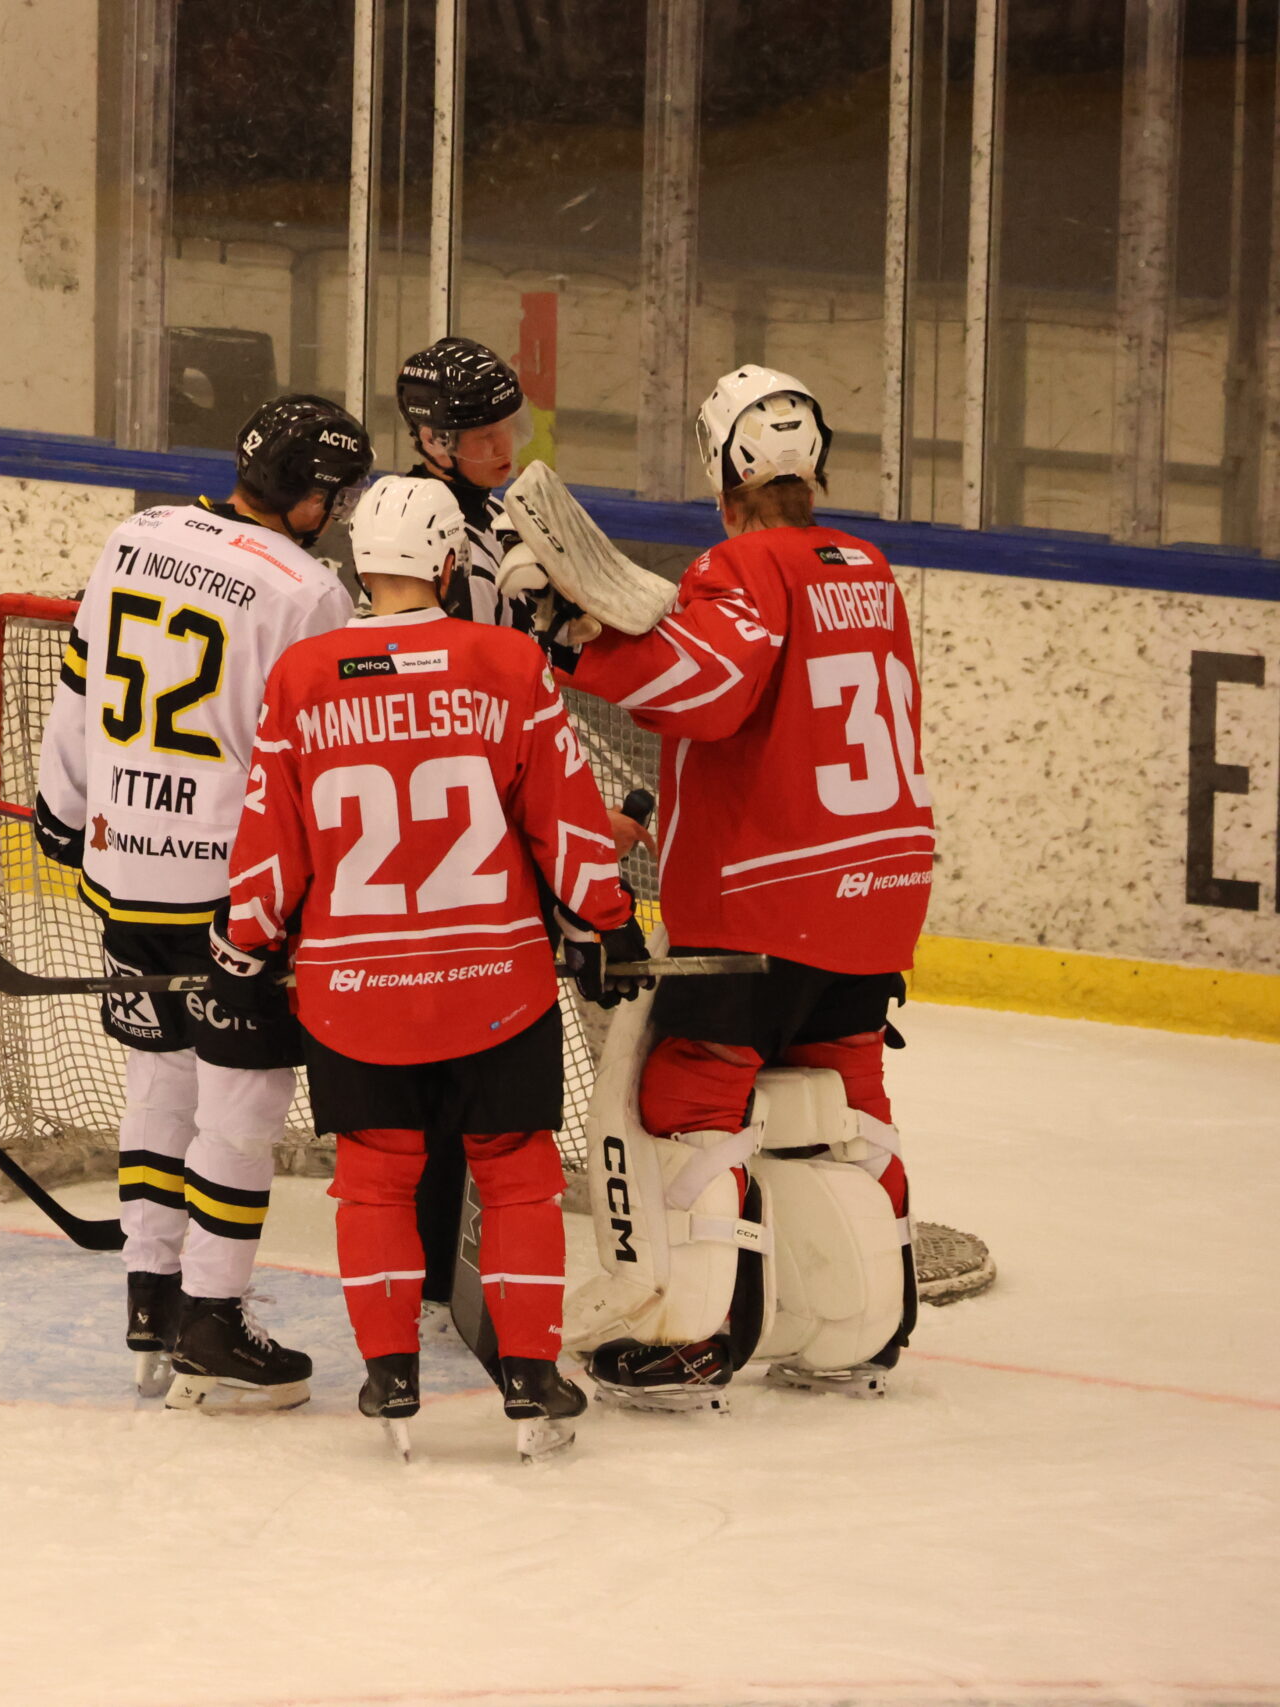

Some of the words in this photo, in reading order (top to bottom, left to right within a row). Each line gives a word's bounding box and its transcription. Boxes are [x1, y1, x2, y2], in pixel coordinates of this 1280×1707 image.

[491, 386, 515, 405] CCM
[408, 406, 431, 416] CCM
[318, 430, 359, 452] ACTIC
[314, 472, 341, 483] CCM
[184, 519, 223, 536] CCM
[143, 552, 257, 610] INDUSTRIER
[101, 587, 230, 764] 52
[357, 660, 390, 672] elfag
[111, 764, 197, 815] YTTAR
[1186, 650, 1280, 913] E
[311, 755, 509, 918] 22
[367, 970, 445, 988] HEDMARK
[447, 960, 514, 982] SERVICE
[603, 1135, 638, 1263] CCM
[736, 1228, 759, 1240] CCM
[683, 1351, 713, 1373] CCM
